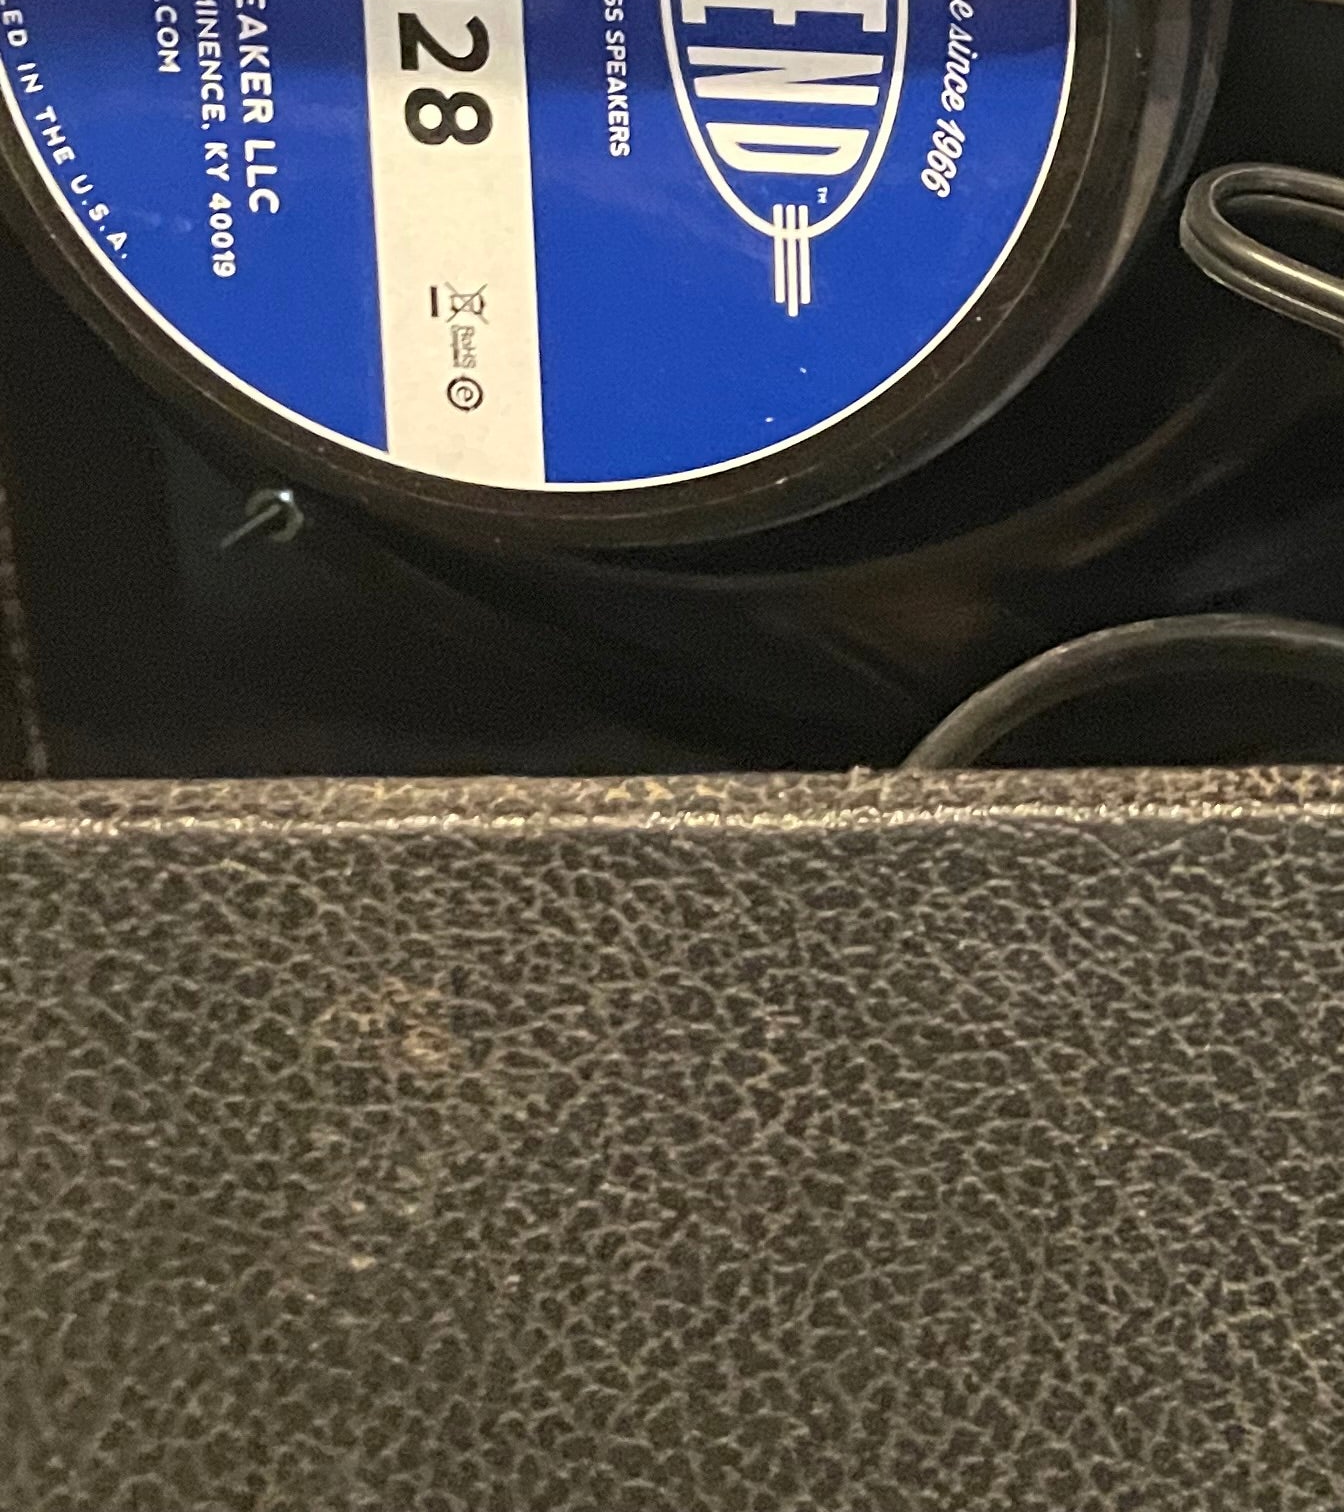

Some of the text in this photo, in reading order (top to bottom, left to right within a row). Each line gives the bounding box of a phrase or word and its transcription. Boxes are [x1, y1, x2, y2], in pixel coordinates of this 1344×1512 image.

[605, 28, 631, 157] SPEAKERS
[941, 22, 979, 112] since
[17, 62, 43, 94] IN
[35, 105, 76, 166] THE
[70, 174, 128, 260] U.S.A.
[204, 141, 230, 182] KY
[244, 140, 280, 214] LLC
[920, 118, 966, 198] 1966
[208, 191, 237, 278] 40019
